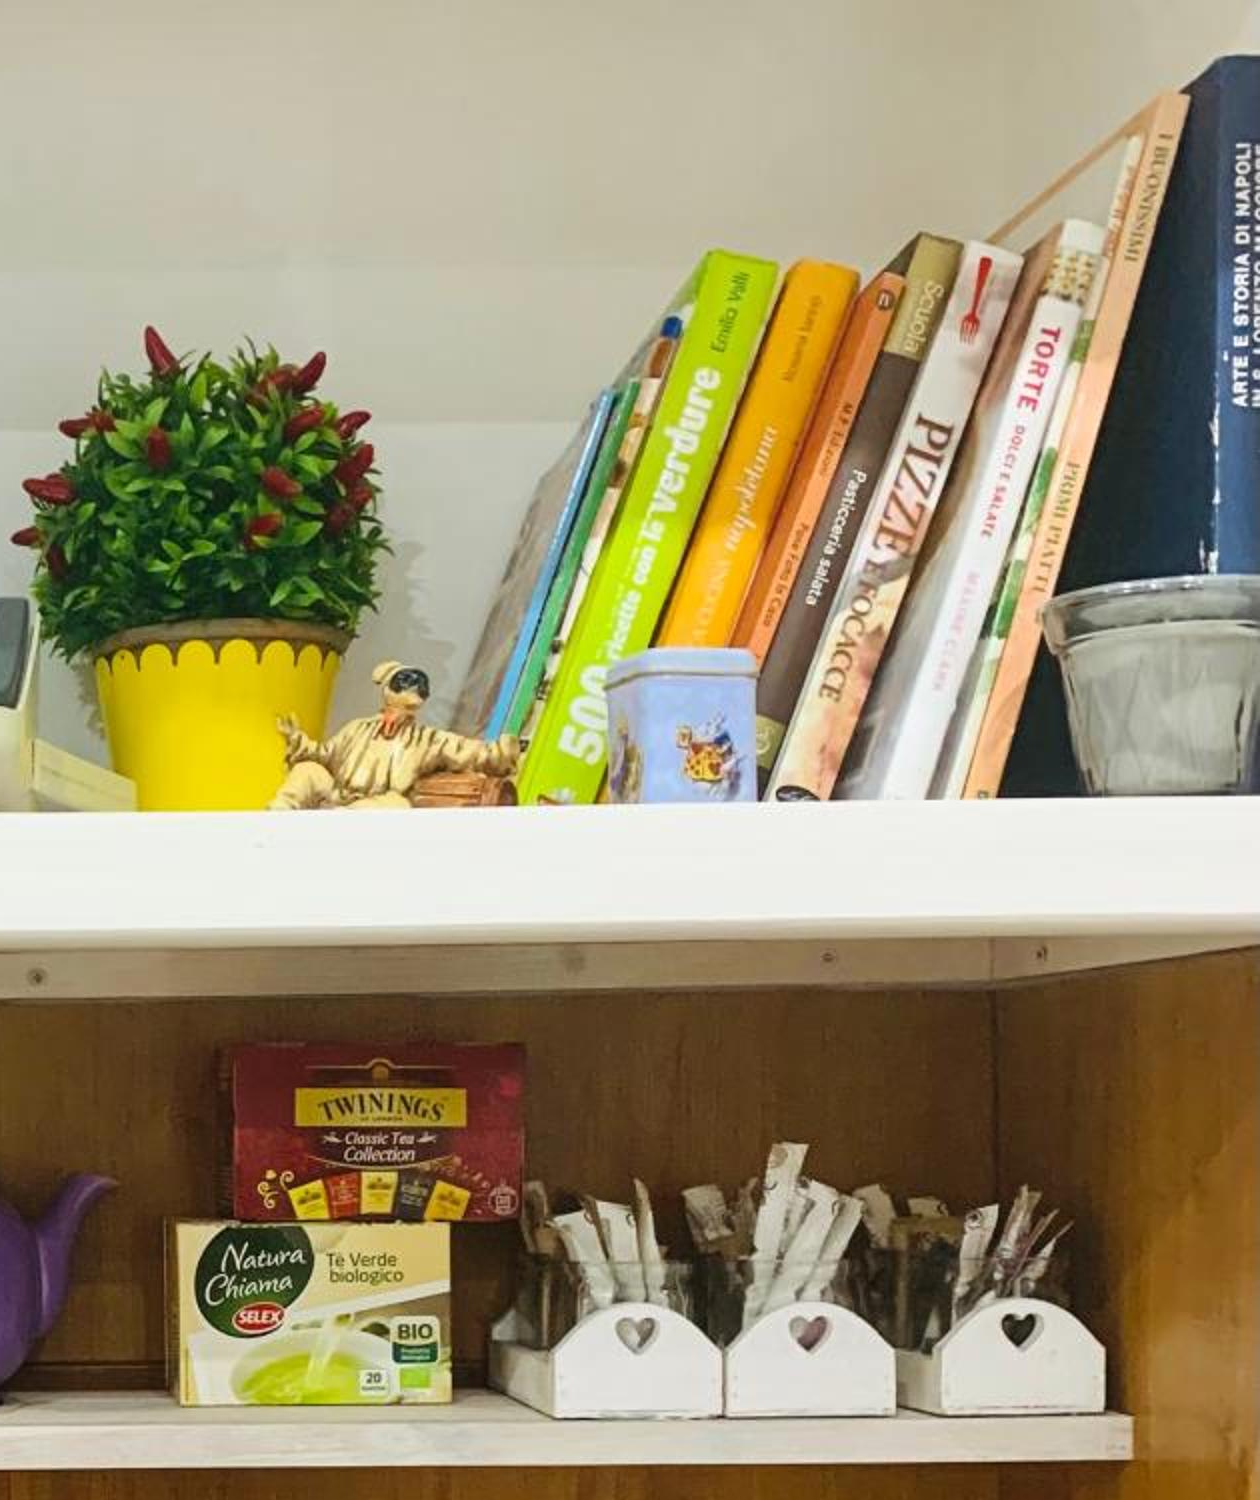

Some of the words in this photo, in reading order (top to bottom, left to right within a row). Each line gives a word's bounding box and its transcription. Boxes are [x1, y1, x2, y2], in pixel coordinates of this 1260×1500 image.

[1124, 146, 1170, 262] BUONISSIMI
[1235, 142, 1252, 217] NAPOLI
[1235, 225, 1251, 245] DI
[1233, 253, 1250, 327] STORIA
[904, 281, 945, 353] Scuola
[1233, 335, 1249, 347] E
[1017, 327, 1062, 413] TORTE
[1232, 354, 1250, 408] ARTE
[654, 367, 721, 513] verdure
[1003, 425, 1025, 470] DOLCI
[872, 412, 954, 558] PIZZE
[1053, 463, 1081, 524] PRIMI
[821, 468, 867, 560] Pasticceria
[980, 483, 1008, 538] SALATE
[805, 557, 837, 607] salata
[1030, 525, 1063, 597] PIATTI
[820, 579, 879, 703] FOCACCE
[318, 1092, 445, 1121] TWININGS
[343, 1146, 416, 1163] Collection
[345, 1131, 389, 1145] Classic
[392, 1131, 415, 1145] Tea
[221, 1242, 307, 1273] Natura
[329, 1268, 404, 1286] biologico
[349, 1251, 397, 1267] Verde
[205, 1273, 293, 1306] Chiama
[236, 1308, 284, 1325] SELEX
[398, 1323, 433, 1340] BIO
[366, 1372, 382, 1384] 20
